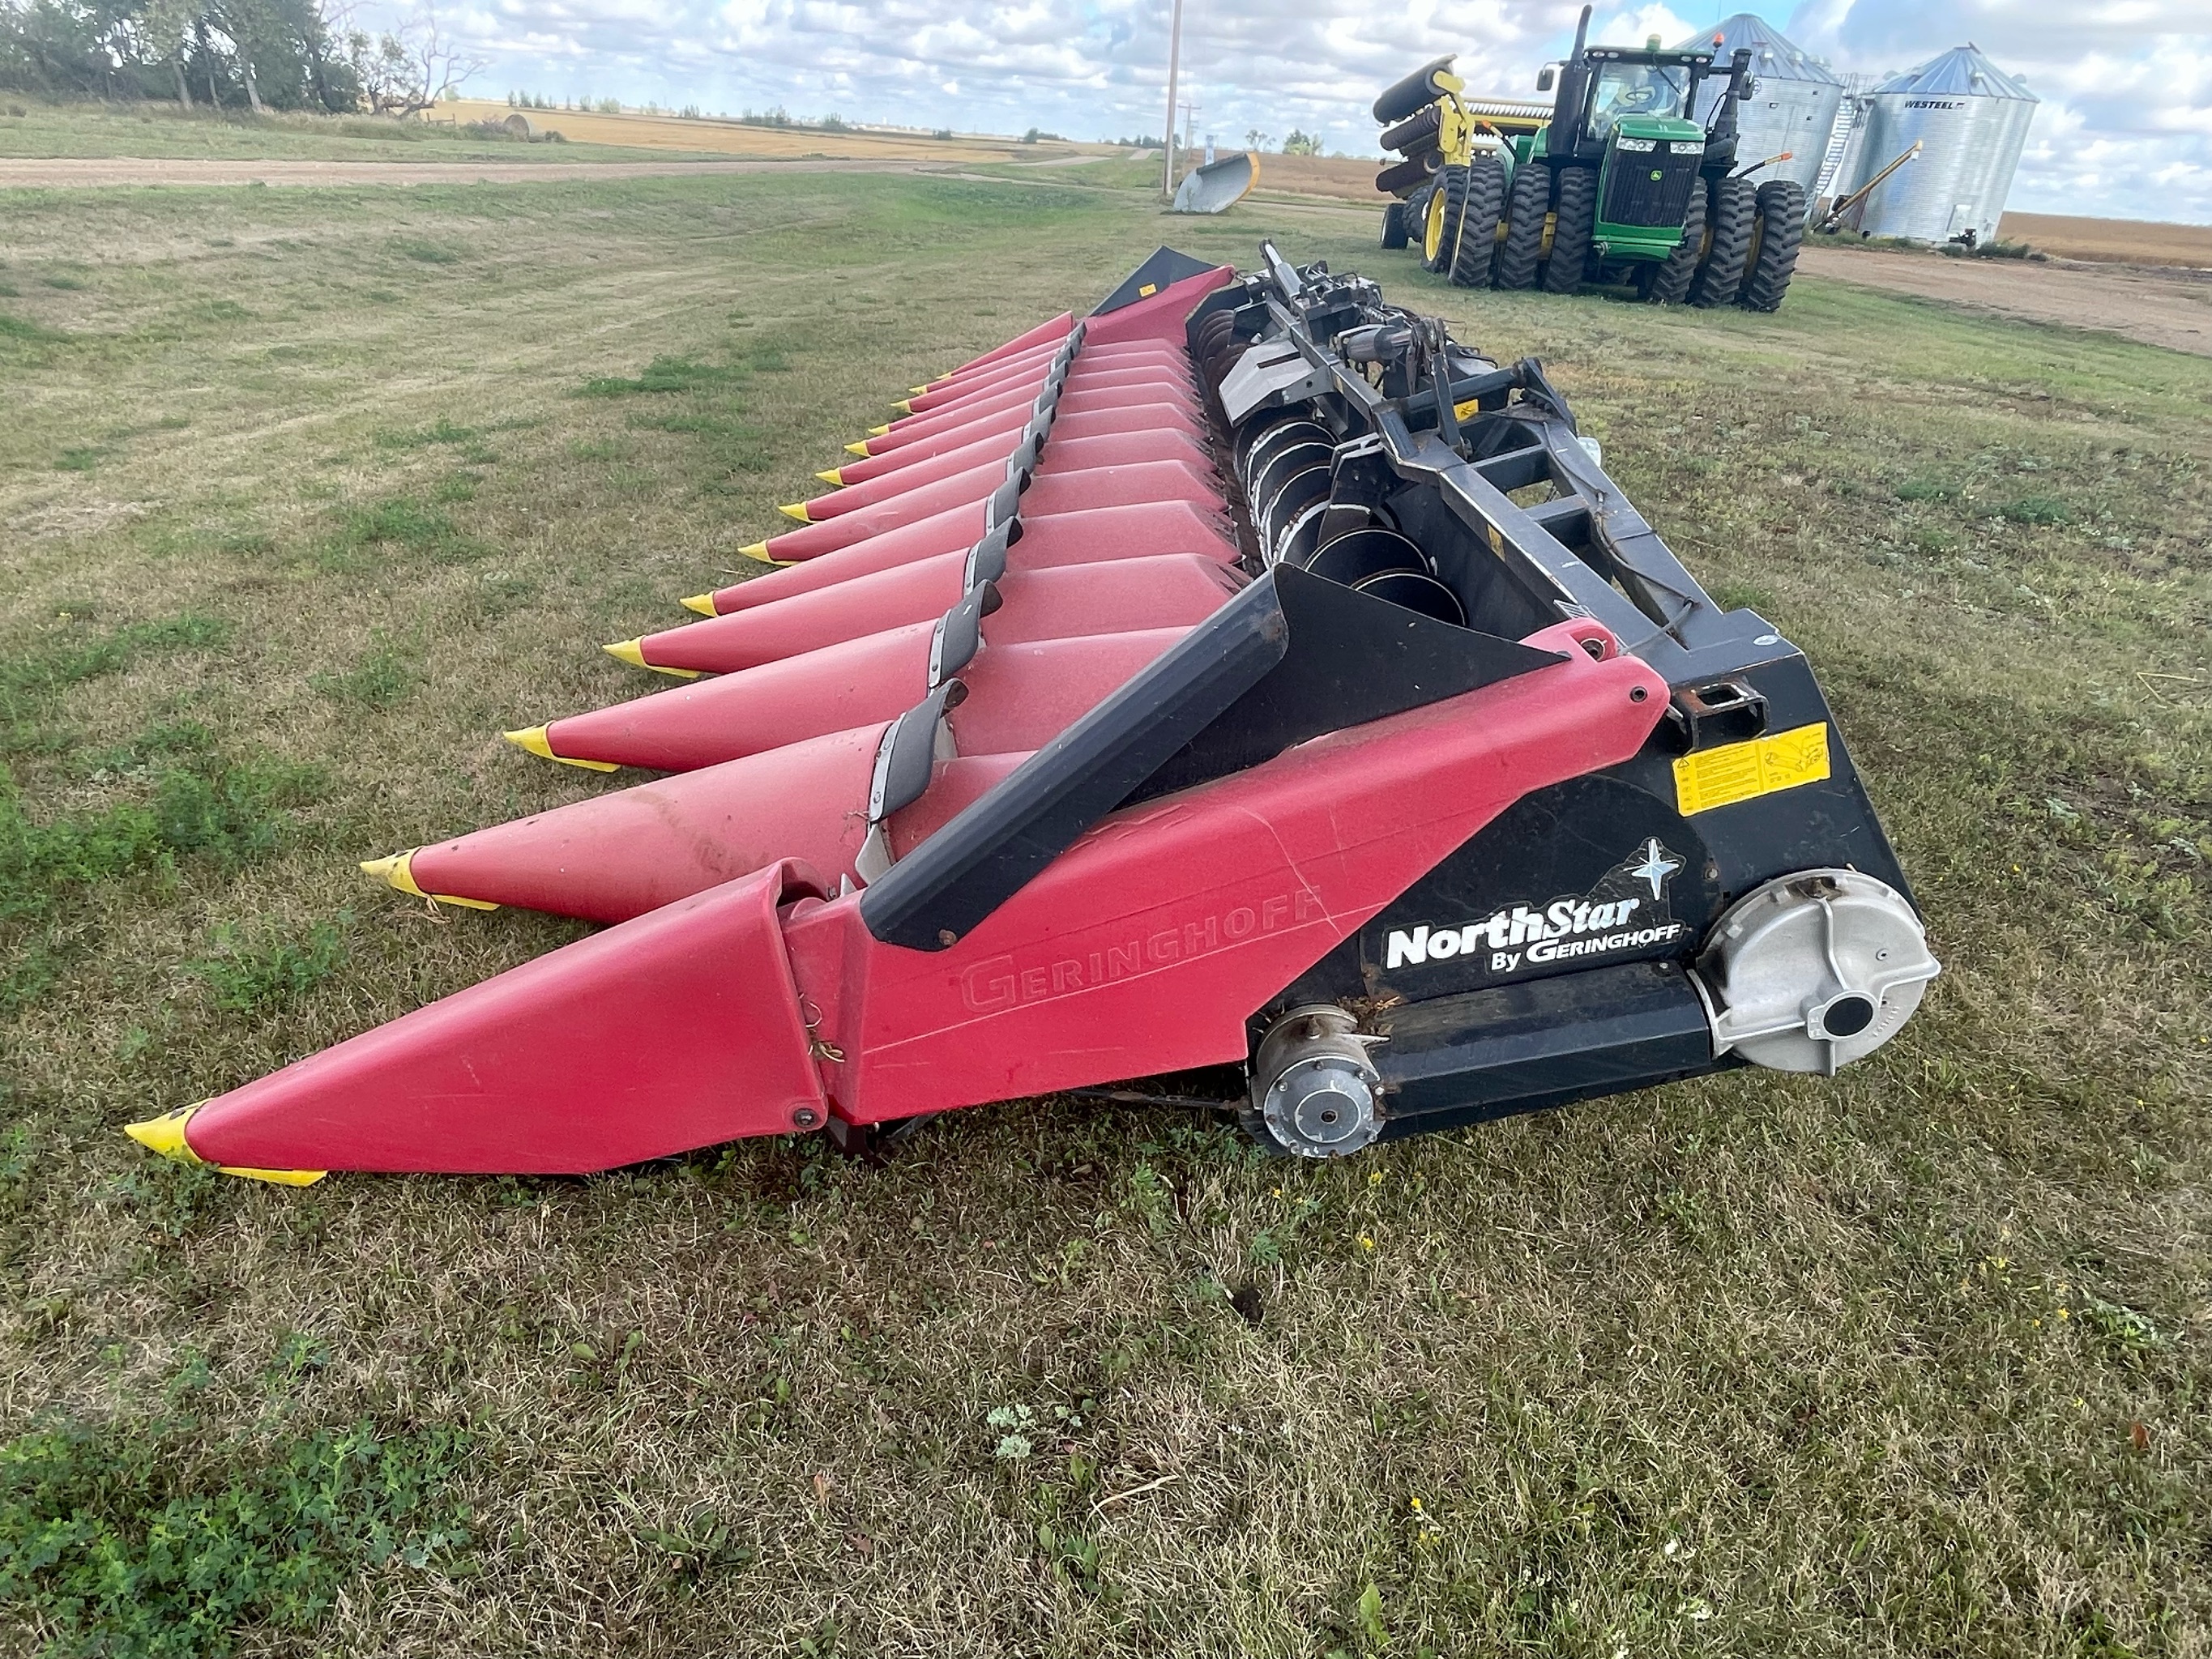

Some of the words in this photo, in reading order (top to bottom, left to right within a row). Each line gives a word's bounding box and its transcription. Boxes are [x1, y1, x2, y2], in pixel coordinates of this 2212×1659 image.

[1905, 100, 1953, 109] WESTEEL
[961, 885, 1322, 1013] GERINGHOFF
[1386, 898, 1640, 969] NorthStar
[1492, 952, 1521, 972] By
[1527, 923, 1681, 962] GERINGHOFF
